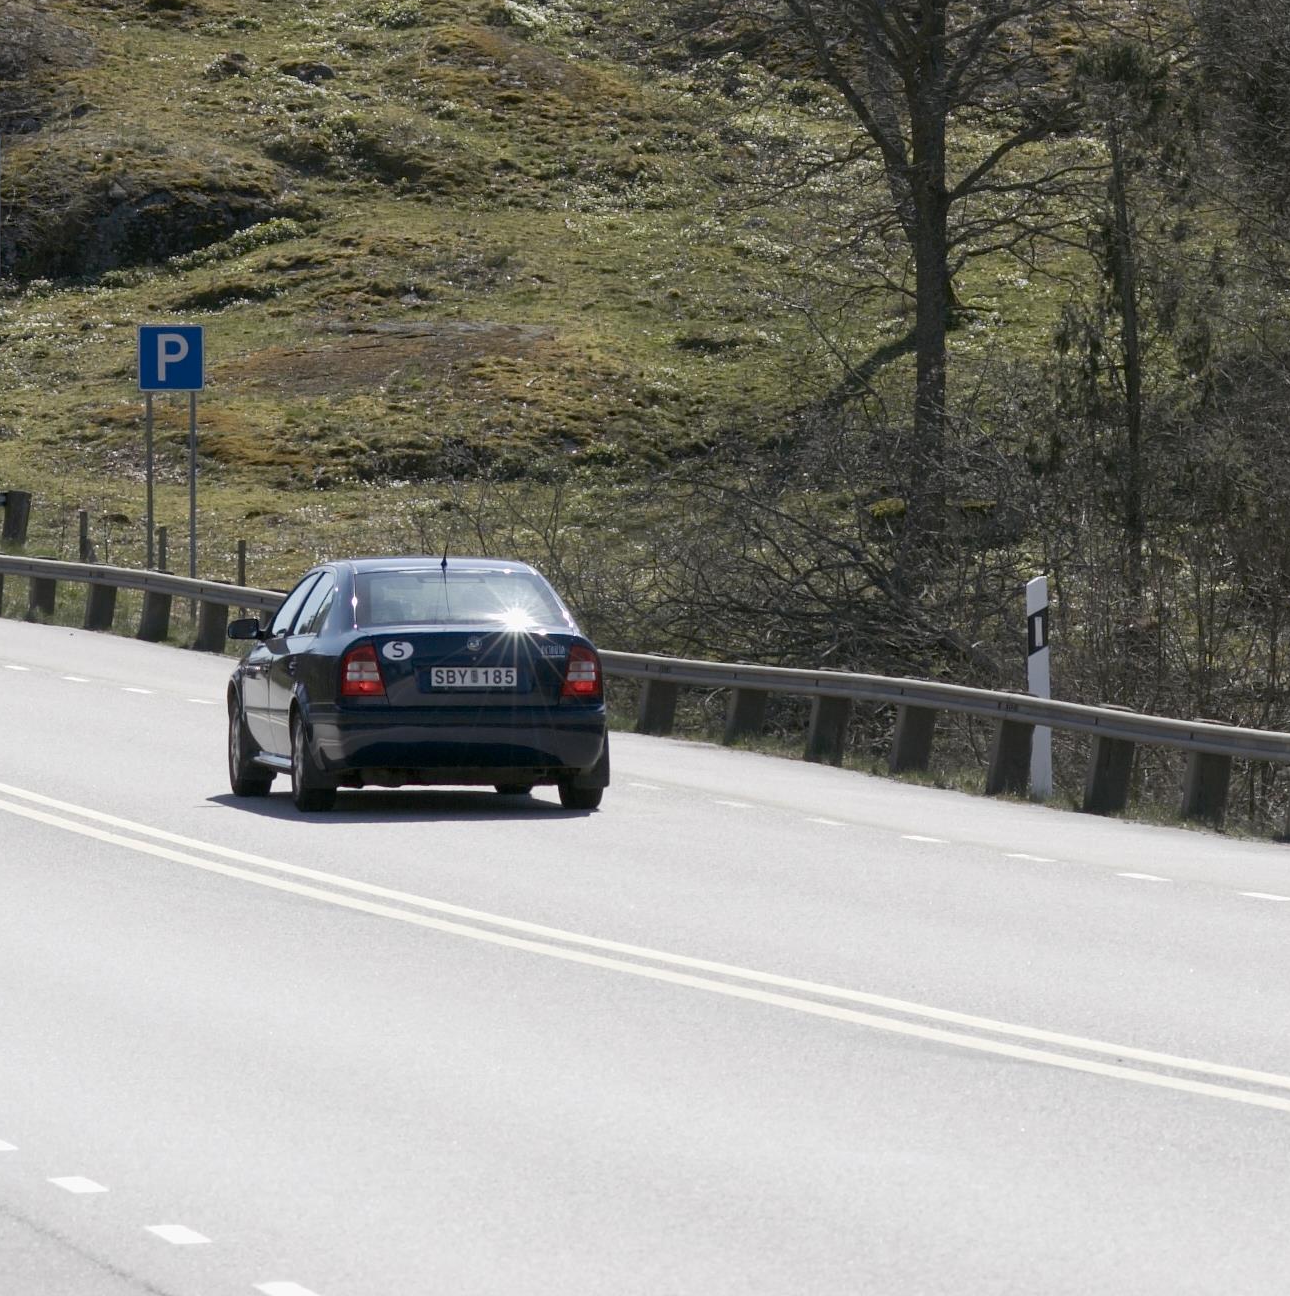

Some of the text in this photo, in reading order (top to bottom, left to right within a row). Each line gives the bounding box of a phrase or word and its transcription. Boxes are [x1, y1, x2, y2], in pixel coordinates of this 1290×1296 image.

[157, 333, 189, 381] P
[392, 642, 405, 658] S
[435, 670, 514, 684] SBY 185
